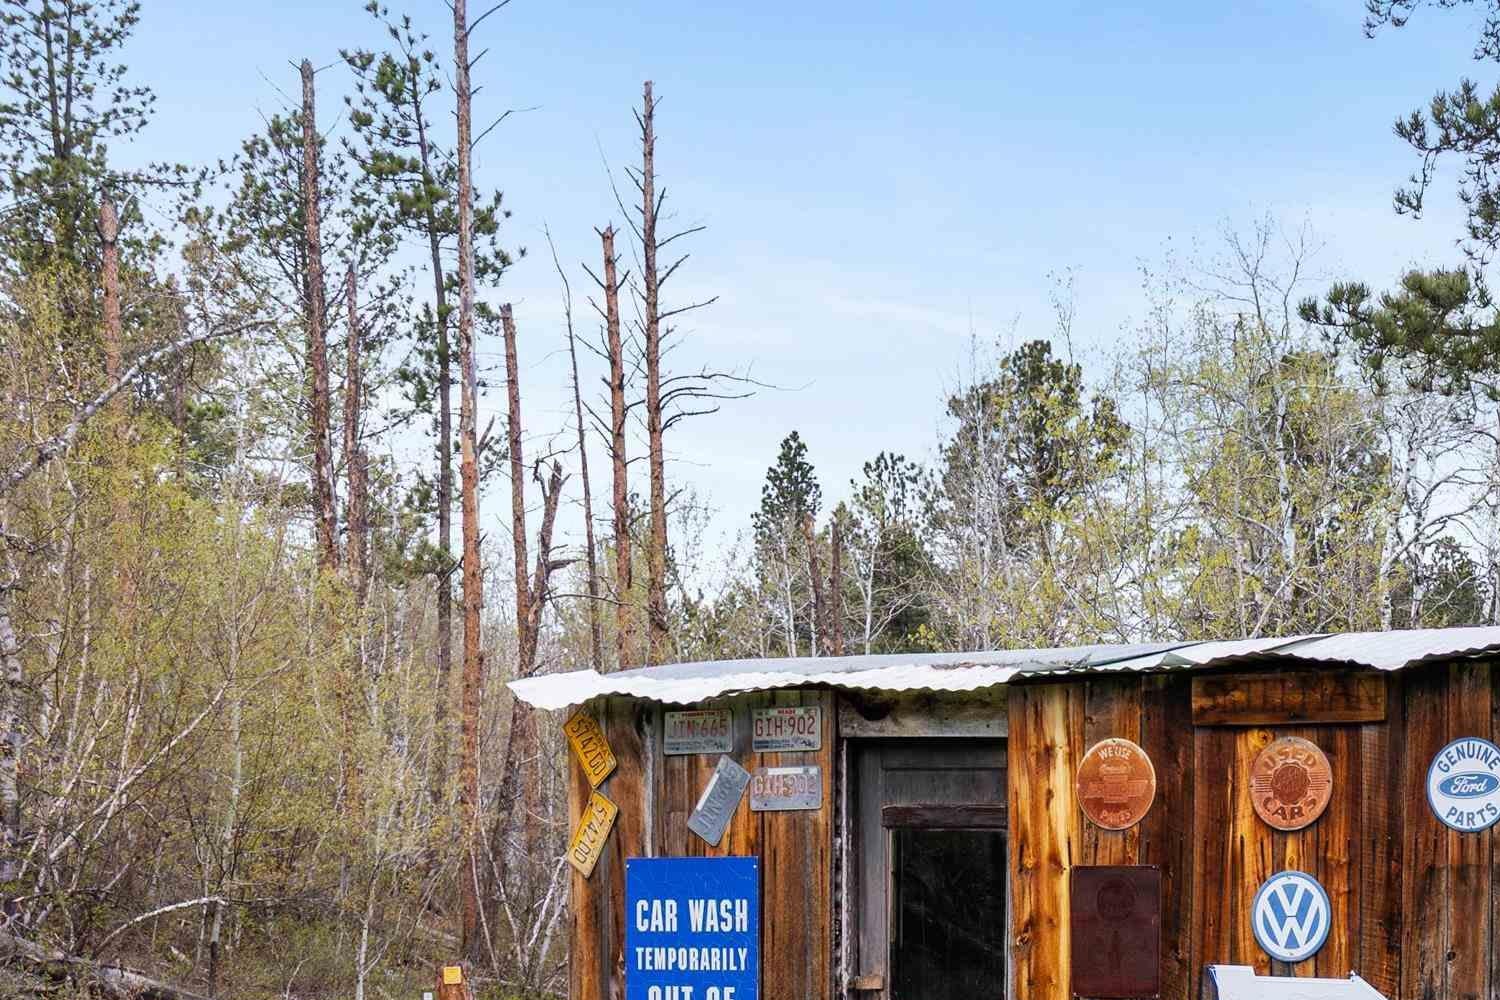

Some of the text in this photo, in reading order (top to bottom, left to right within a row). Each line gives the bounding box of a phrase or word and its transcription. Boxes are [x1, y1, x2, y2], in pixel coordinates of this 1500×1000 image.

[1263, 746, 1317, 768] USED
[1450, 775, 1489, 794] Ford
[1263, 796, 1317, 821] CARS
[1445, 802, 1498, 826] PARTS
[636, 898, 749, 934] CAR WASH
[635, 946, 749, 972] TEMPORARILY
